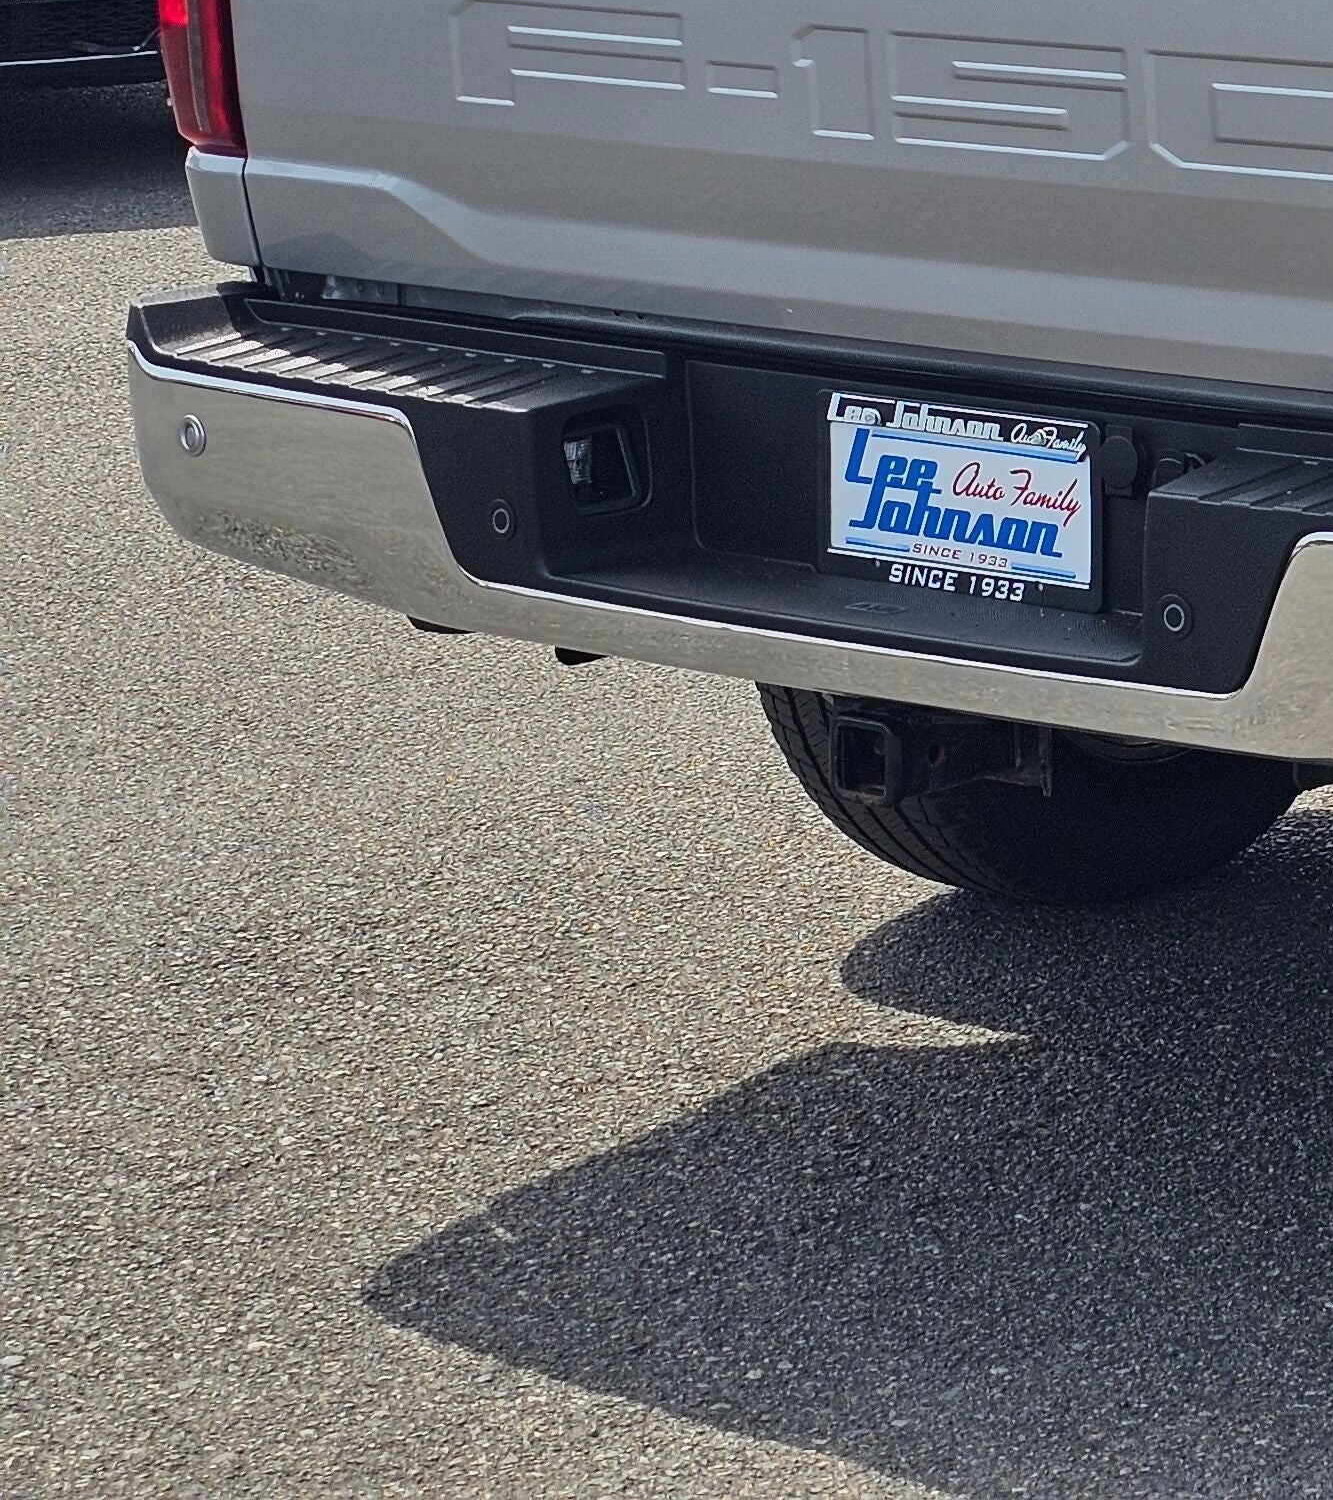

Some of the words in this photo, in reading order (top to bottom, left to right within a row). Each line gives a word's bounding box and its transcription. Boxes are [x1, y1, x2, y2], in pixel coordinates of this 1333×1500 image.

[845, 428, 941, 495] Lee
[886, 401, 1004, 442] Johnson
[1042, 426, 1087, 461] Family
[849, 487, 1062, 558] Johnson
[952, 462, 1007, 501] Auto
[1010, 469, 1082, 527] Family
[888, 563, 957, 592] SINCE
[968, 575, 1026, 602] 1933
[912, 542, 963, 561] SINCE
[969, 551, 1009, 569] 1933
